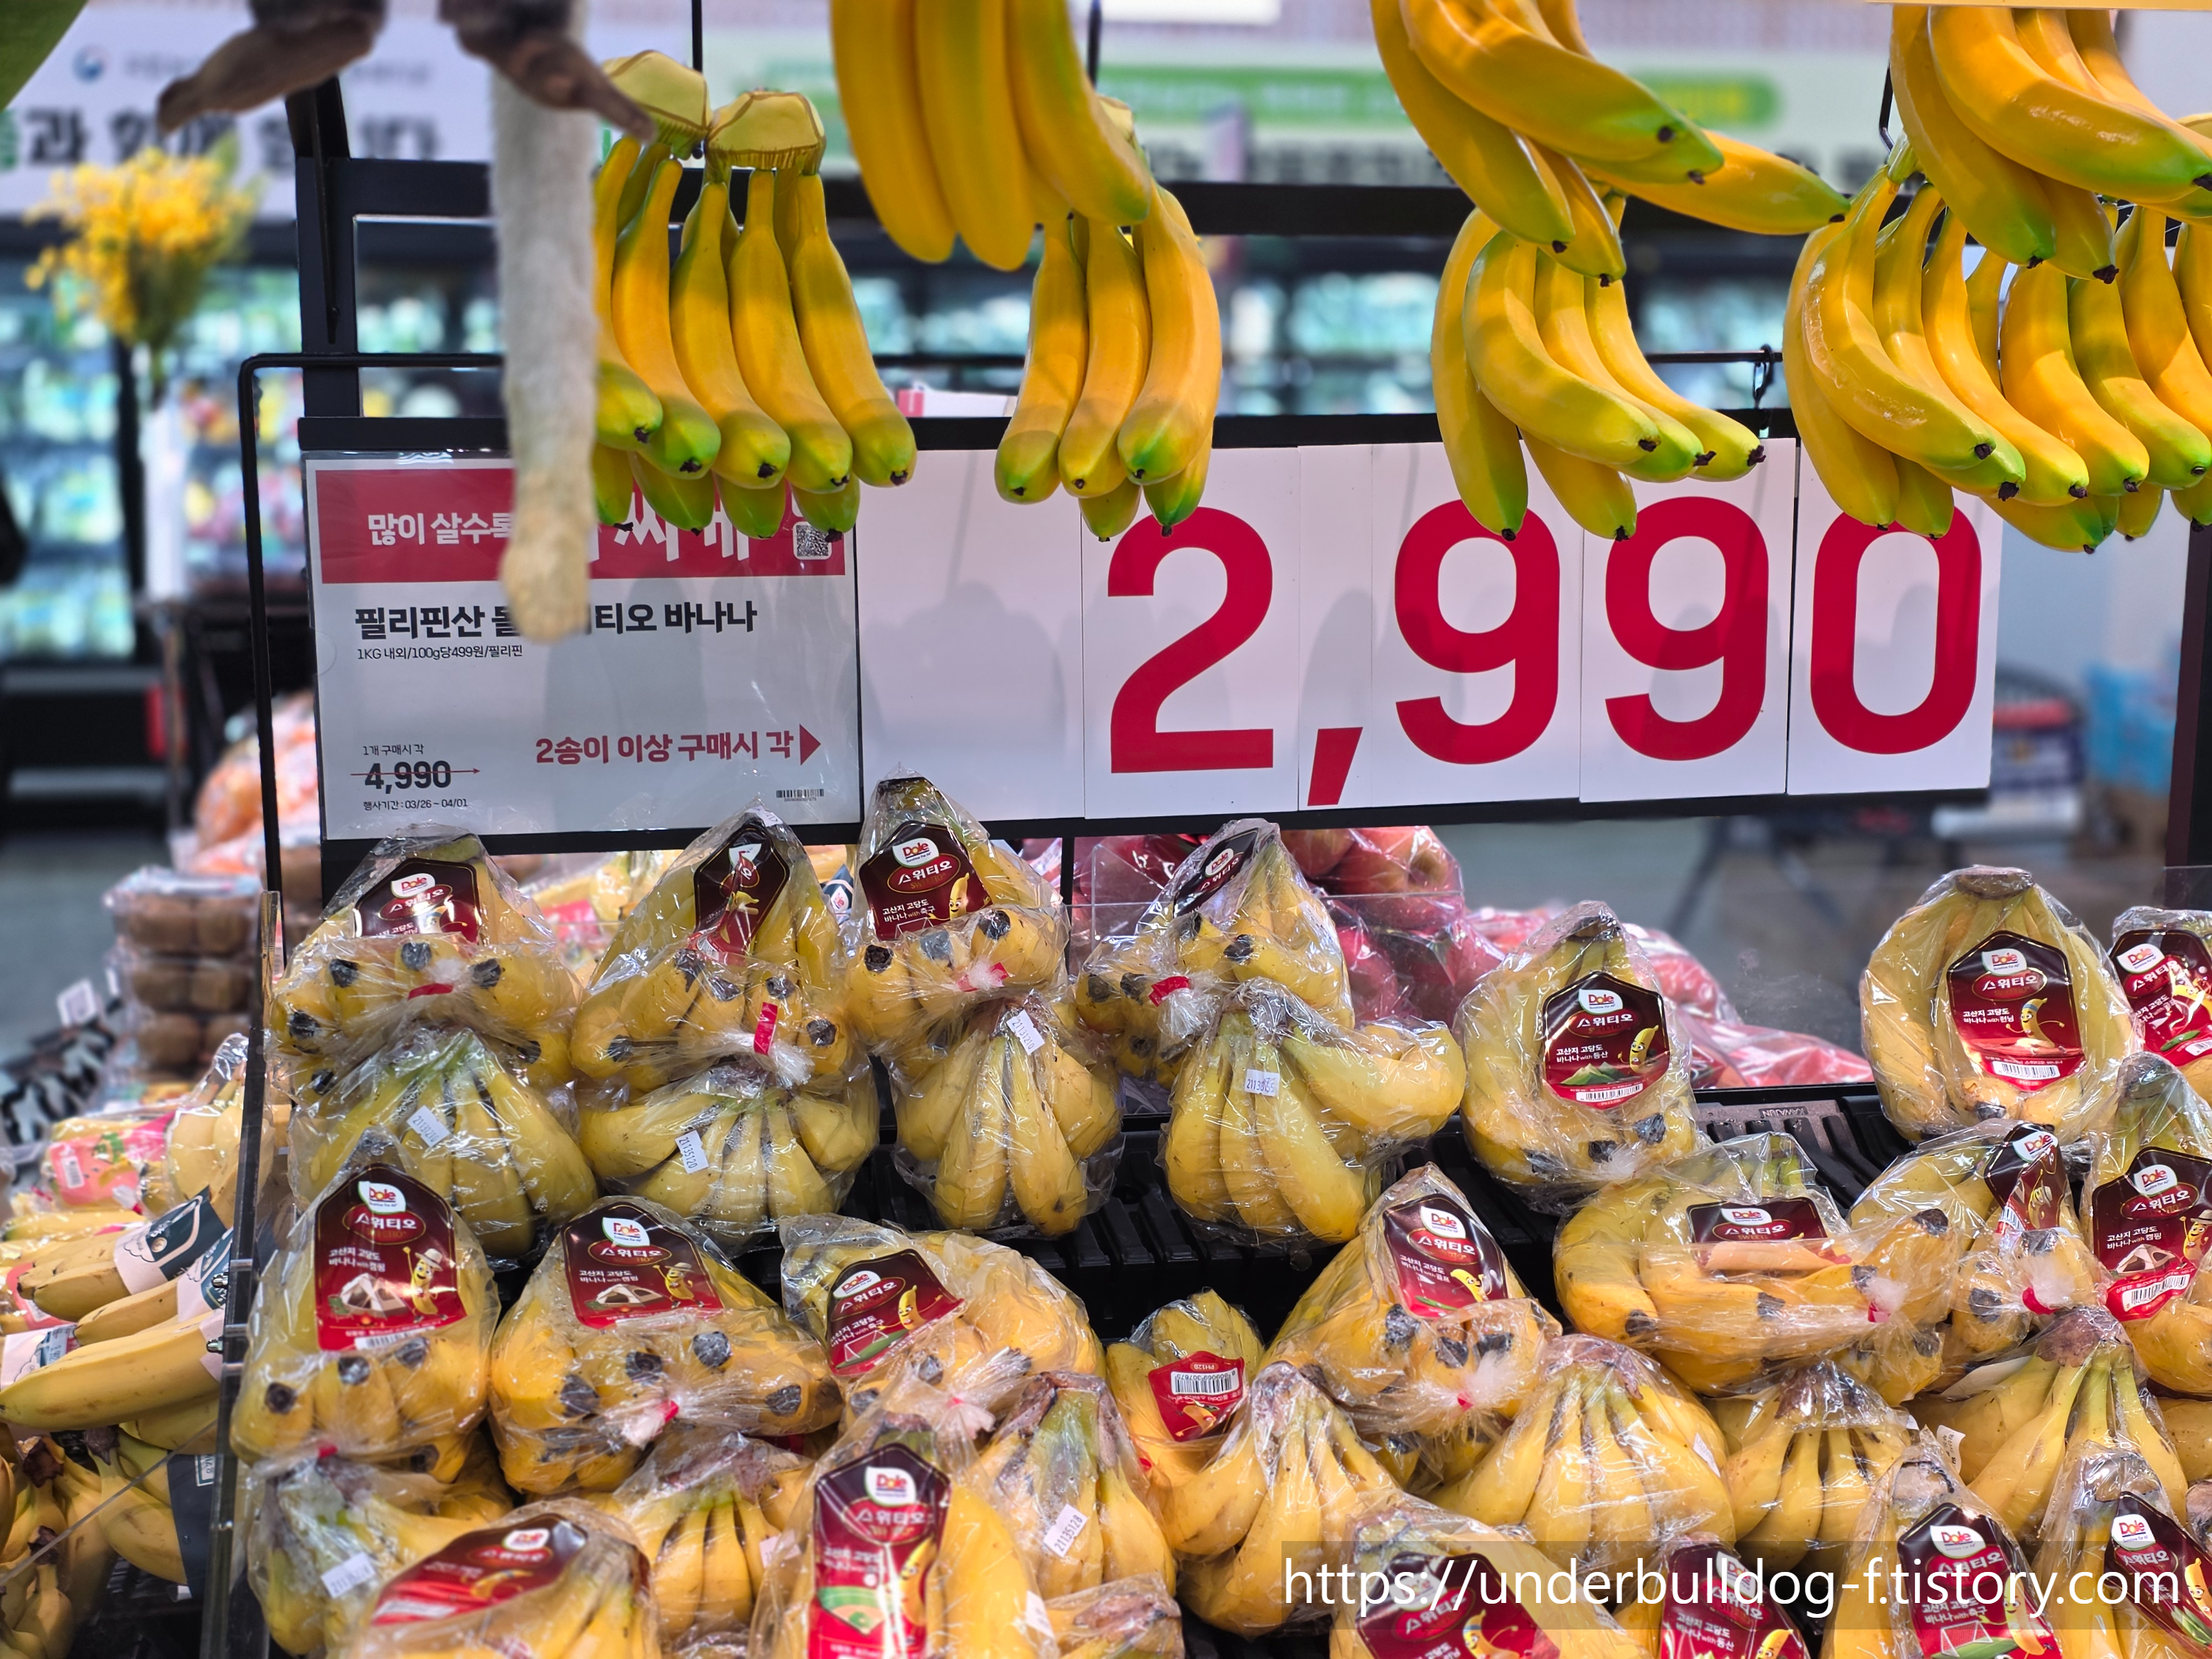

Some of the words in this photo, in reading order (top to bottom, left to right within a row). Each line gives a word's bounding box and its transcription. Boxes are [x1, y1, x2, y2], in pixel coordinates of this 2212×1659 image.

[368, 513, 425, 546] 많이
[355, 606, 485, 639] 필리핀산
[664, 600, 757, 633] 바나나
[358, 648, 382, 660] 1KG
[384, 645, 523, 660] 내외/100g당499원/필리핀
[1107, 496, 1982, 806] 2,990
[363, 745, 380, 756] 1개
[380, 744, 412, 756] 구매시
[414, 743, 425, 755] 각
[535, 735, 609, 765] 2송이
[617, 734, 672, 763] 이상
[678, 731, 758, 761] 구매시
[765, 730, 794, 759] 각
[364, 760, 451, 794] 4,990
[442, 799, 468, 808] 04/01
[902, 842, 929, 858] Dole
[1211, 852, 1229, 872] Dole
[897, 860, 953, 886] 스위티오
[1200, 858, 1239, 891] 스위티오
[400, 876, 428, 890] Dole
[882, 905, 905, 915] 고산지
[907, 899, 930, 910] 고당도
[884, 911, 908, 922] 바나나
[1992, 953, 2018, 964] Dole
[2127, 947, 2152, 963] Dole
[1982, 975, 2038, 991] 스위티오
[1588, 994, 1614, 1004] Dole
[2149, 994, 2170, 1009] 고당도
[1576, 1013, 1632, 1028] 스위티오
[1963, 1009, 1985, 1018] 고산지
[1987, 1008, 2010, 1016] 고당도
[1556, 1046, 1579, 1056] 고산지
[1581, 1044, 1603, 1053] 고당도
[1557, 1054, 1579, 1063] 바나나
[1593, 1051, 1608, 1059] 등산
[2024, 1135, 2052, 1152] Dole
[678, 1137, 698, 1169] 21135120
[2142, 1169, 2167, 1186] Dole
[369, 1188, 396, 1200] Dole
[2132, 1191, 2190, 1212] 스위티오
[355, 1213, 417, 1230] 스위티오
[1431, 1213, 1457, 1226] Dole
[613, 1222, 640, 1236] Dole
[1725, 1225, 1786, 1235] 스위티오
[2107, 1231, 2130, 1242] 고산지
[2132, 1225, 2157, 1237] 고당도
[1418, 1236, 1475, 1255] 스위티오
[2107, 1239, 2131, 1250] 바나나
[329, 1248, 355, 1257] 고산지
[600, 1248, 662, 1257] 스위티오
[329, 1257, 355, 1267] 바나나
[1400, 1255, 1421, 1267] 고산지
[1423, 1262, 1445, 1275] 고당도
[1401, 1262, 1423, 1273] 바나나
[842, 1274, 869, 1290] Dole
[841, 1281, 897, 1313] 스위티오
[852, 1315, 876, 1329] 고당도
[855, 1327, 869, 1336] with
[876, 1475, 906, 1488] Dole
[858, 1509, 924, 1524] 스위티오
[2119, 1520, 2145, 1535] Dole
[1941, 1531, 1972, 1545] Dole
[1921, 1603, 1949, 1613] 고산지
[1924, 1613, 1952, 1624] 바나나
[1953, 1612, 1969, 1620] with
[1704, 1622, 1731, 1638] 고당도
[1701, 1635, 1717, 1645] with
[1717, 1639, 1734, 1651] 등산
